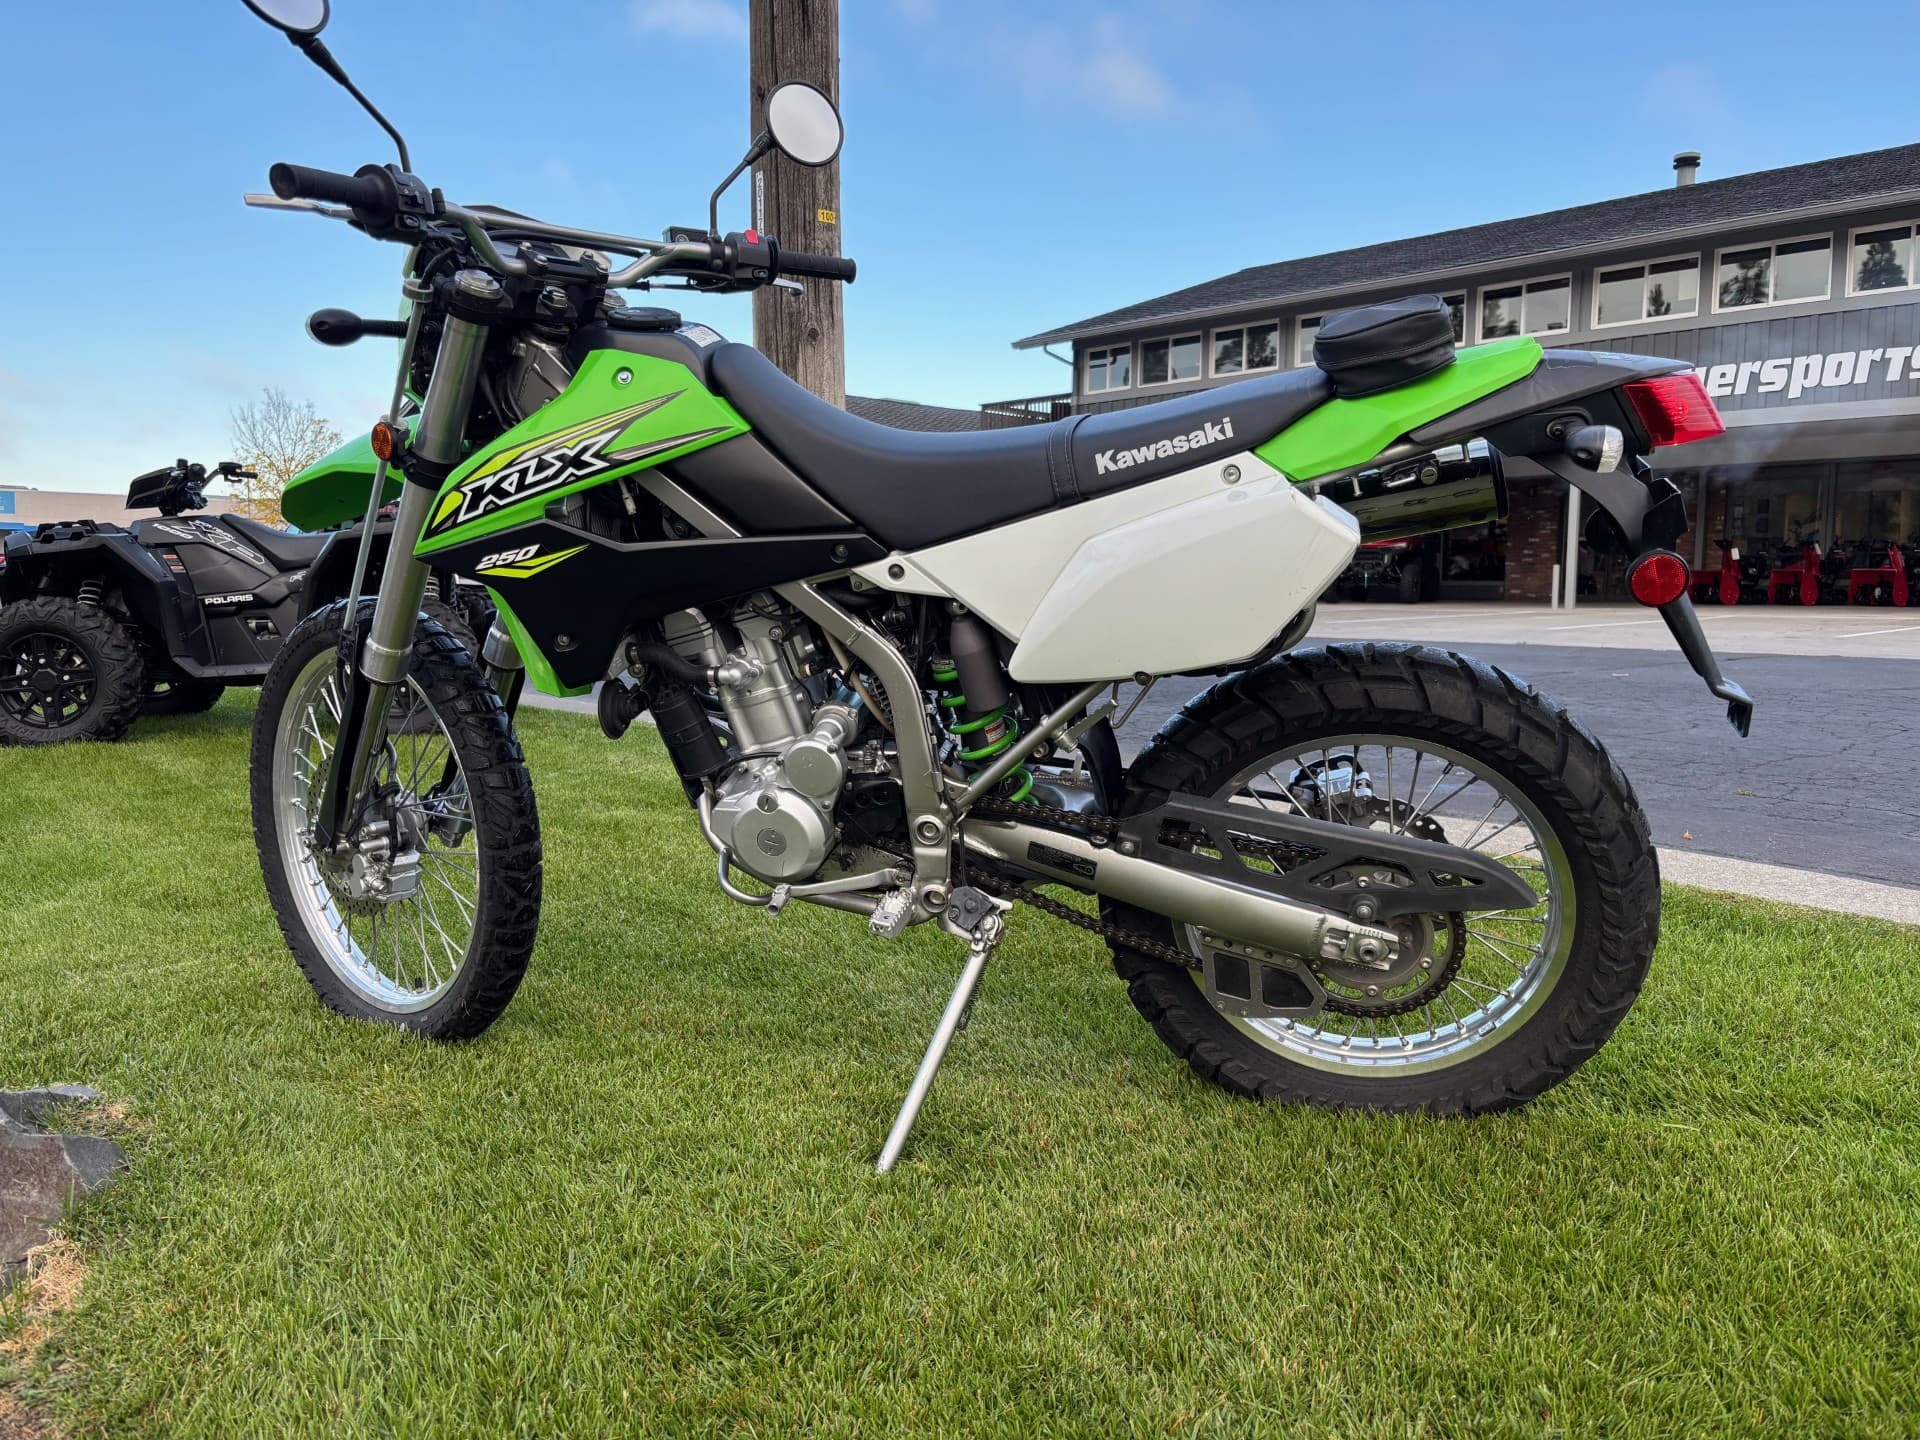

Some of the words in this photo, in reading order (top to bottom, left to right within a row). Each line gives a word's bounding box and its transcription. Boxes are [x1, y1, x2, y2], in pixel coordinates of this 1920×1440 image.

[1094, 416, 1234, 475] Kawasaki
[456, 428, 622, 524] KLX
[152, 522, 194, 539] 1000
[475, 543, 541, 571] 250
[204, 593, 254, 605] POLARIS
